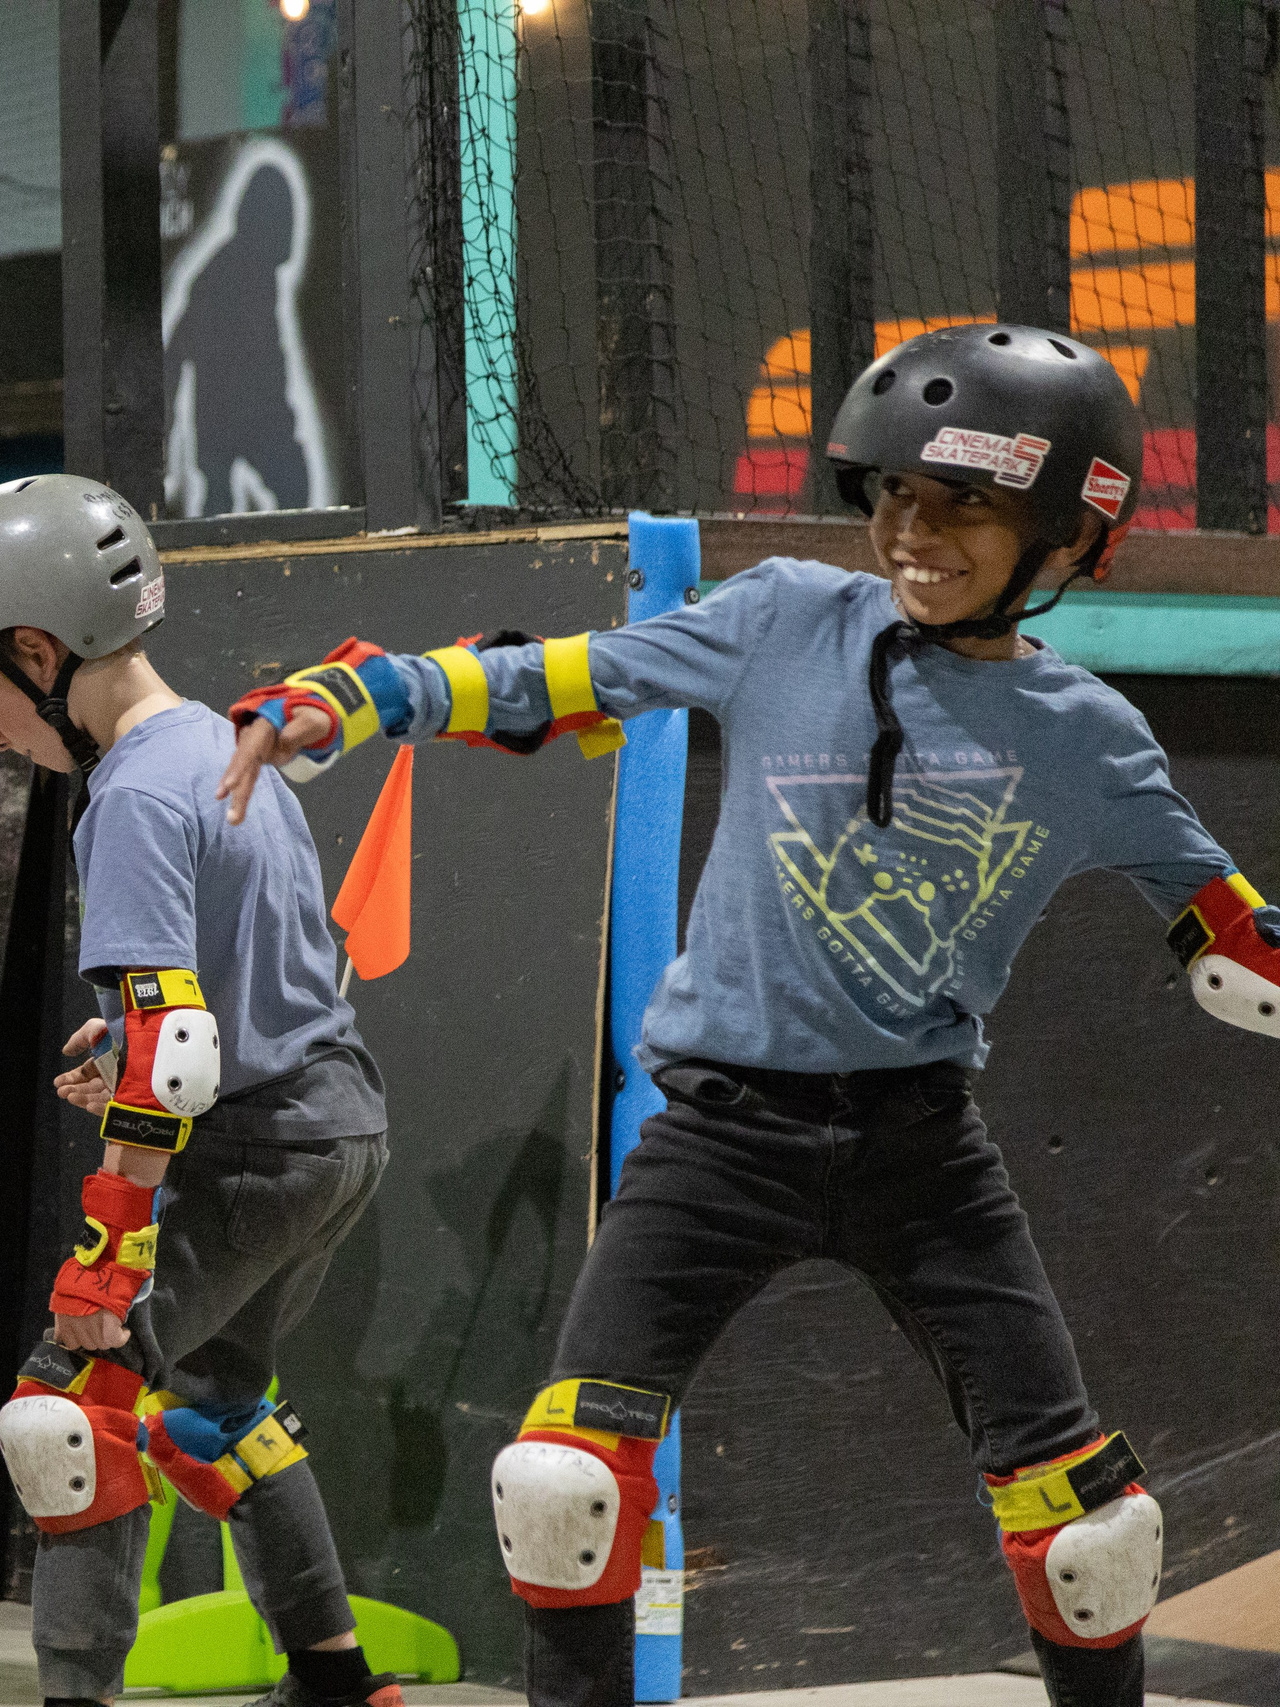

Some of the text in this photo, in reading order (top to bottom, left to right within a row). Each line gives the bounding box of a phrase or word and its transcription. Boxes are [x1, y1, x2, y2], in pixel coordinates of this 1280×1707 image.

[938, 430, 1013, 454] CINEMA
[925, 445, 1019, 472] SKATEPARK
[142, 580, 165, 600] CINEM
[761, 753, 847, 769] GAMERS
[955, 750, 1018, 766] GAME
[962, 890, 1013, 941] GOTTA
[1010, 825, 1050, 879] GAME
[816, 926, 873, 987] GOTTA
[51, 1361, 74, 1378] TEC
[546, 1391, 565, 1414] L
[579, 1401, 657, 1423] PRO TEC
[1039, 1486, 1071, 1512] L
